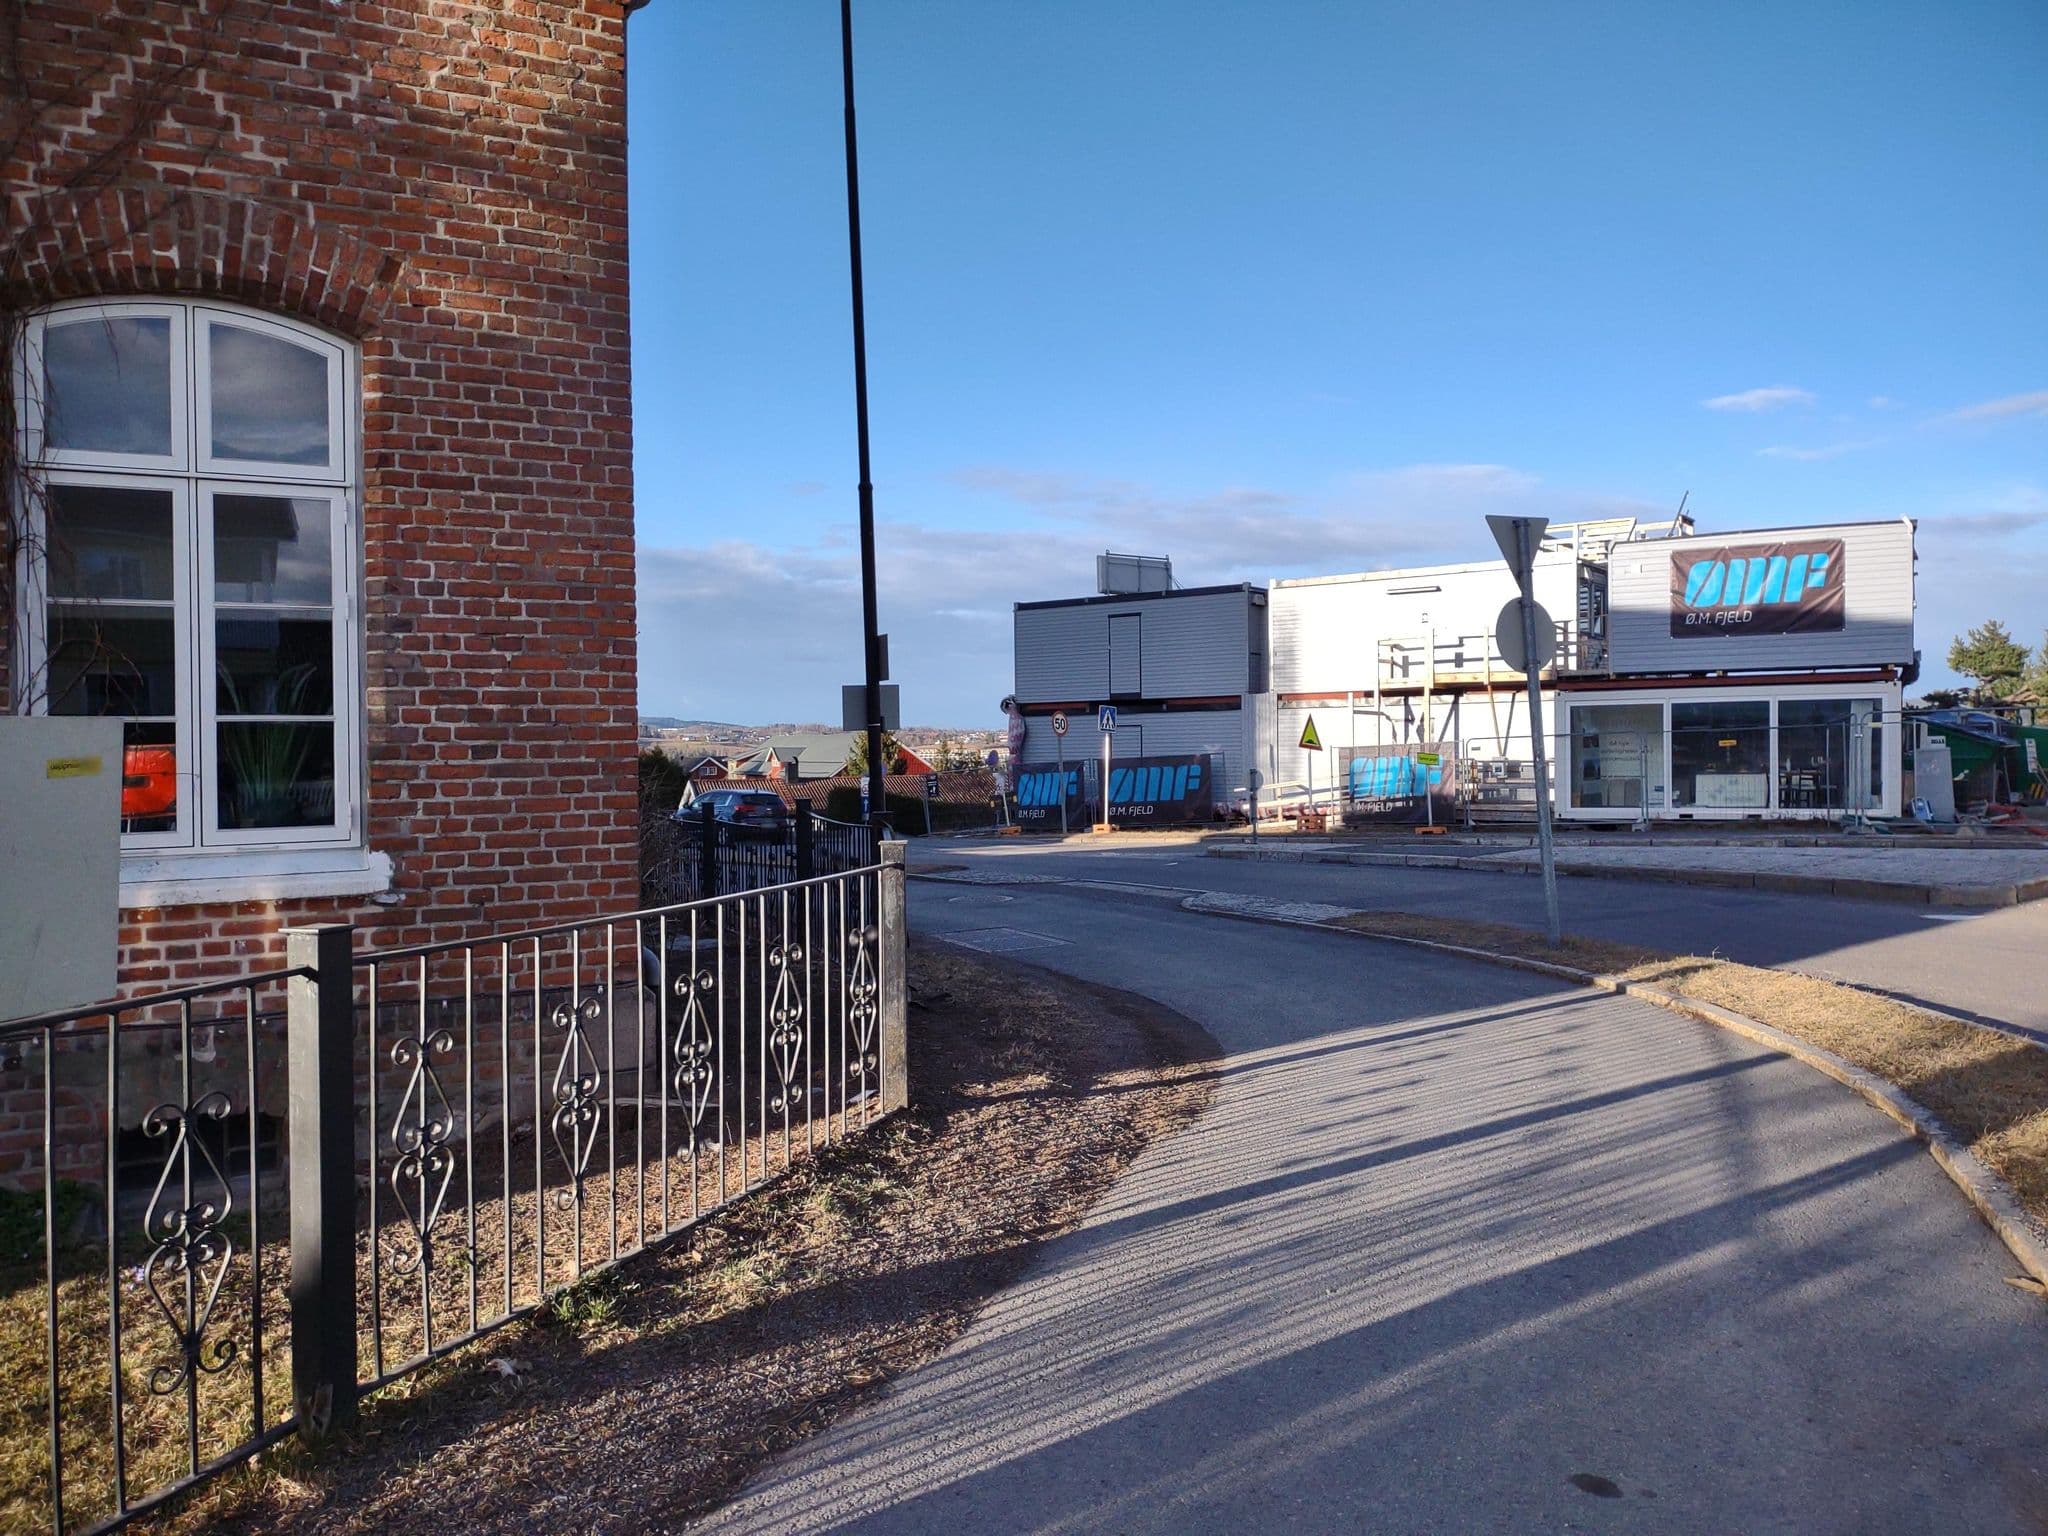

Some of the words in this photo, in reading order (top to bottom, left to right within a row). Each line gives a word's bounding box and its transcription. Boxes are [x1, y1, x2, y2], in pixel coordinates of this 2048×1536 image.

[1714, 610, 1753, 625] FJELD
[1054, 717, 1066, 731] 50
[1028, 809, 1046, 819] FJELD
[1128, 805, 1154, 817] FJELD
